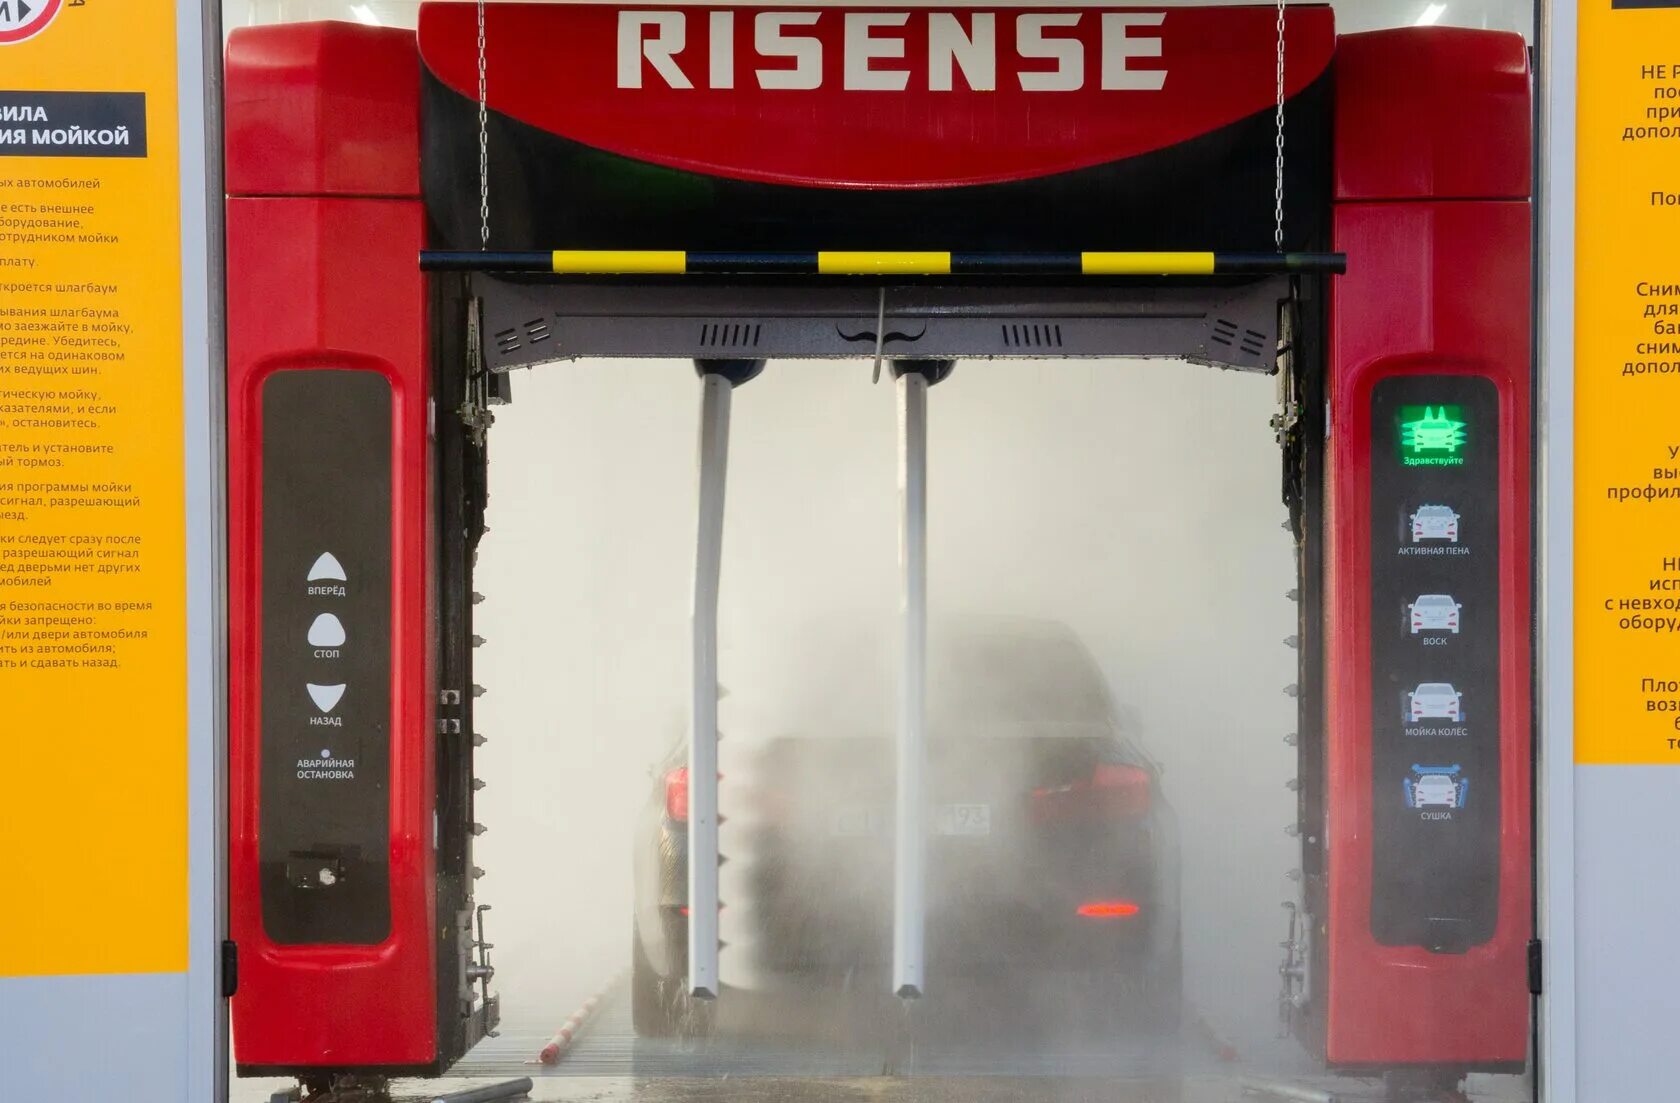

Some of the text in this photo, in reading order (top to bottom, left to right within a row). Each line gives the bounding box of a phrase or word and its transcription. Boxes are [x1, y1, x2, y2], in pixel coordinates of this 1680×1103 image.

[617, 11, 1168, 92] RISENSE
[1642, 65, 1666, 79] НЕ
[1655, 88, 1680, 99] по
[0, 106, 48, 121] ИЛА
[32, 125, 129, 145] МОЙКОЙ
[17, 178, 100, 189] автомобилей
[1651, 192, 1680, 205] По
[11, 204, 37, 213] есть
[40, 205, 94, 214] внешнее
[79, 232, 119, 243] мойки
[56, 282, 117, 295] шлагбаум
[0, 307, 119, 319] ывания шлагбаума
[1644, 304, 1678, 318] для
[15, 321, 78, 332] заезжайте
[1654, 320, 1680, 334] ба
[0, 351, 125, 361] ется на одинаковом
[14, 366, 68, 376] ведущих
[88, 406, 116, 414] если
[44, 444, 114, 455] установите
[1668, 446, 1679, 459] У
[1404, 456, 1463, 465] Здравствуйте
[1654, 468, 1680, 479] вы
[17, 483, 89, 494] программы
[92, 482, 132, 492] мойки
[50, 496, 140, 508] разрешающий
[18, 535, 67, 546] следует
[70, 536, 103, 546] сразу
[106, 536, 141, 544] после
[3, 548, 139, 560] разрешающий сигнал
[1398, 546, 1470, 555] АКТИВНАЯ ПЕНА
[18, 564, 71, 574] дверьми
[75, 564, 95, 572] нет
[98, 564, 140, 574] других
[1663, 557, 1680, 571] Н
[308, 585, 346, 597] ВПЕРЁД
[10, 601, 94, 611] безопасности
[98, 603, 112, 611] во
[115, 602, 152, 612] время
[1605, 598, 1613, 610] с
[1619, 614, 1680, 632] обору
[32, 631, 70, 641] двери
[73, 628, 148, 639] автомобиля
[1423, 637, 1447, 646] ВОСК
[314, 649, 339, 658] СТОП
[31, 659, 79, 669] сдавать
[1642, 678, 1680, 692] Пло
[1647, 701, 1680, 711] воз
[310, 716, 342, 727] НАЗАД
[1405, 726, 1468, 736] МОЙКА КОЛЁС
[297, 757, 354, 768] АВАРИЙНАЯ
[297, 770, 354, 779] ОСТАНОВКА
[1421, 811, 1451, 820] СУШКА
